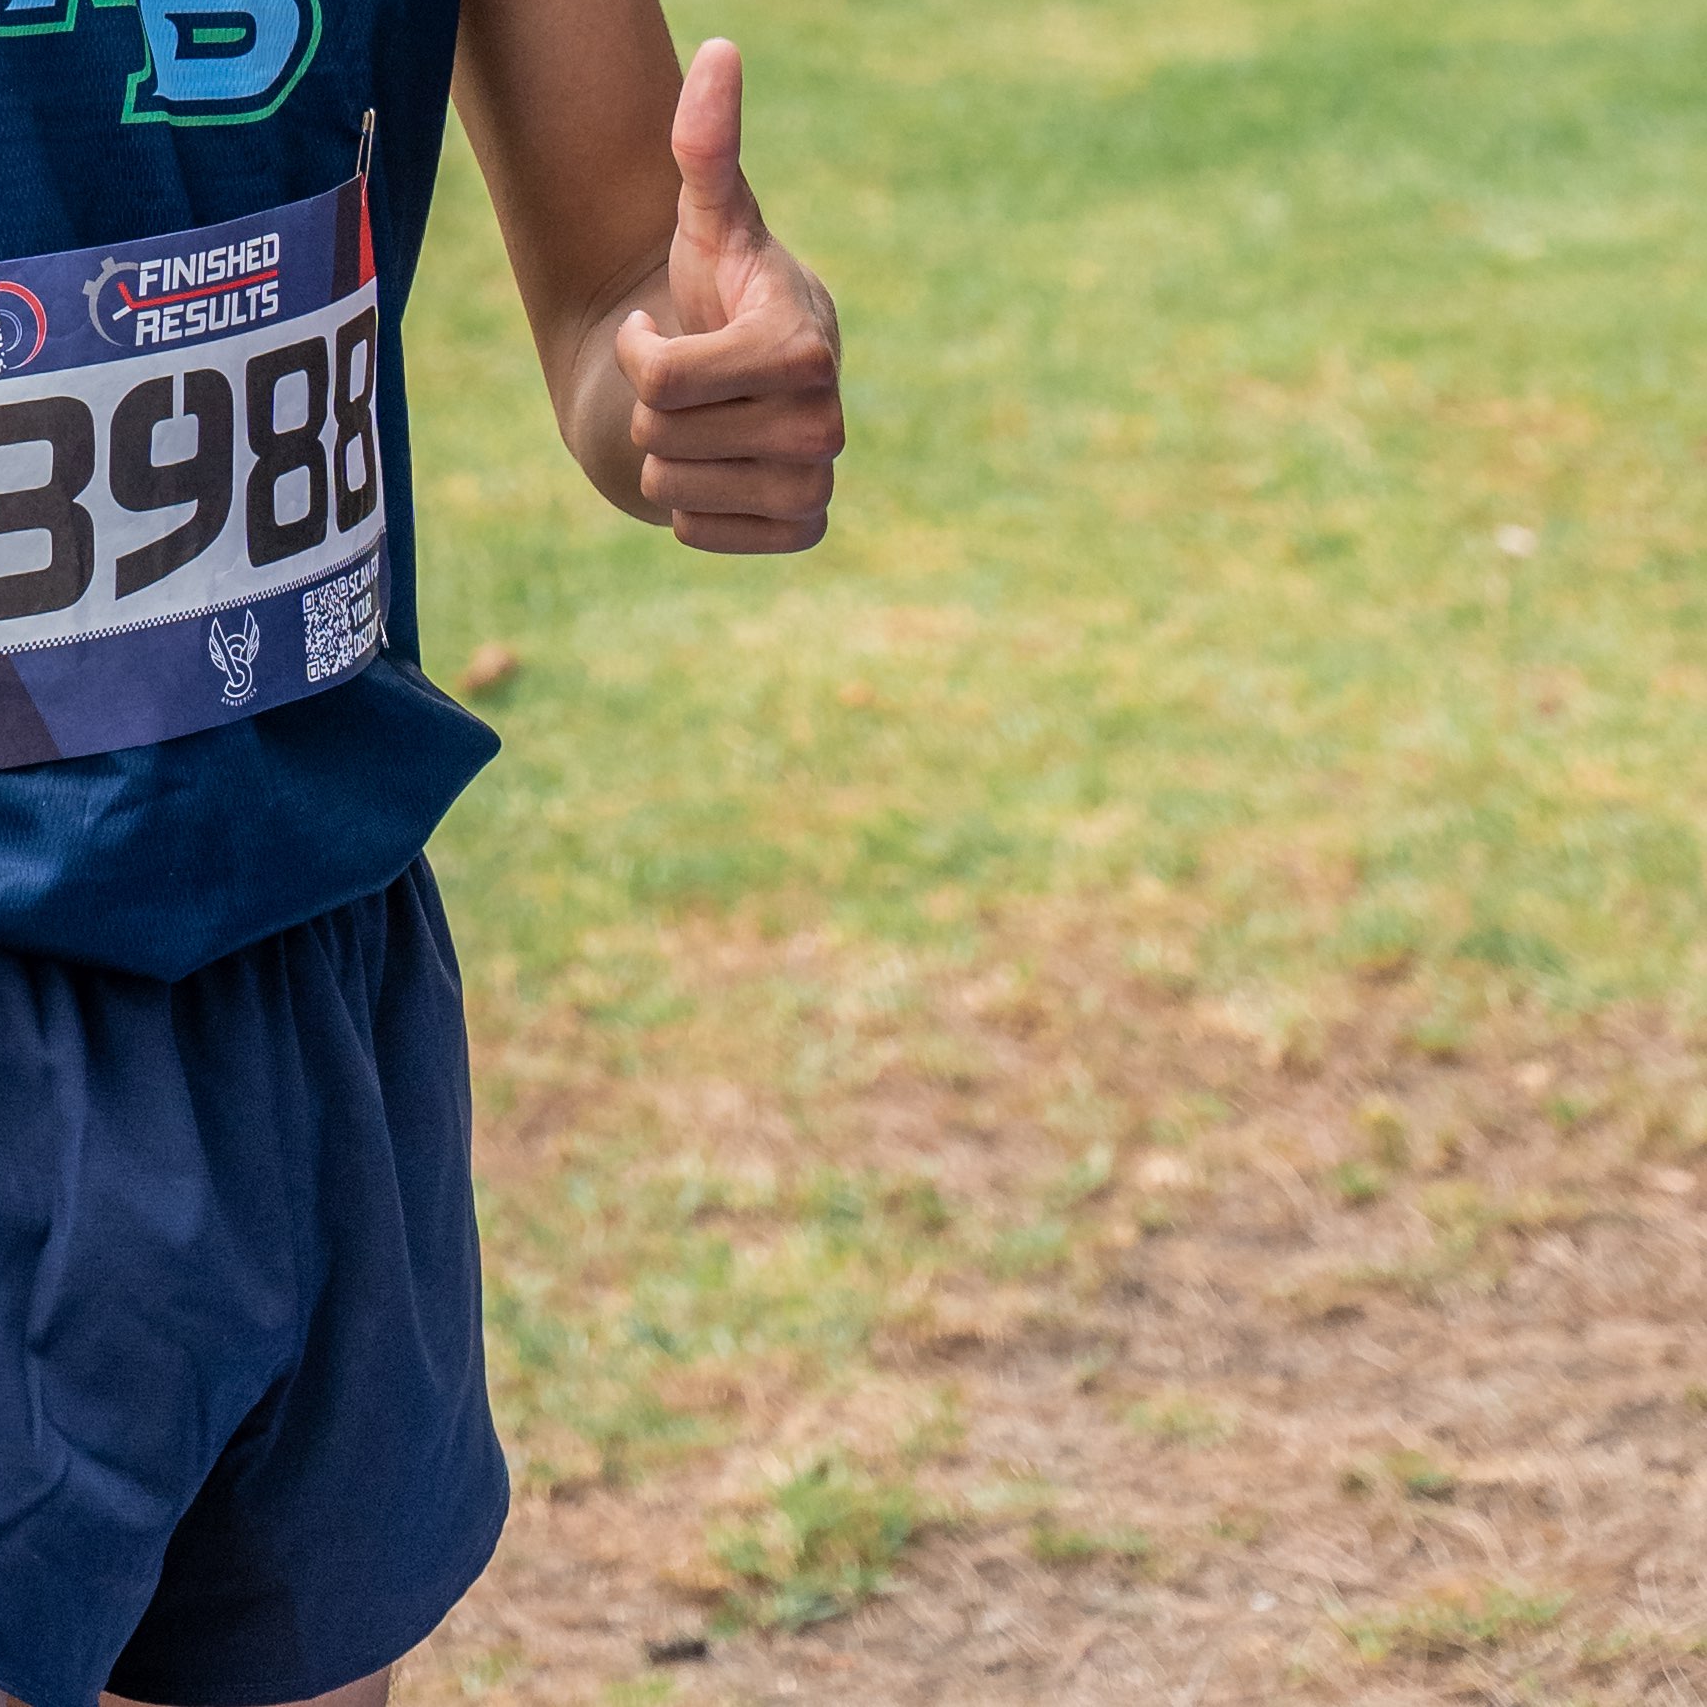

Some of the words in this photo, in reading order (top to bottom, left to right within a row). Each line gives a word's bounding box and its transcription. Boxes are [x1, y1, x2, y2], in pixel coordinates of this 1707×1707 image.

[138, 232, 280, 297] FINISHED
[135, 280, 279, 347] RESULTS
[348, 562, 371, 598] SCAN
[351, 591, 372, 627] YOUR
[353, 616, 378, 658] DISCOU
